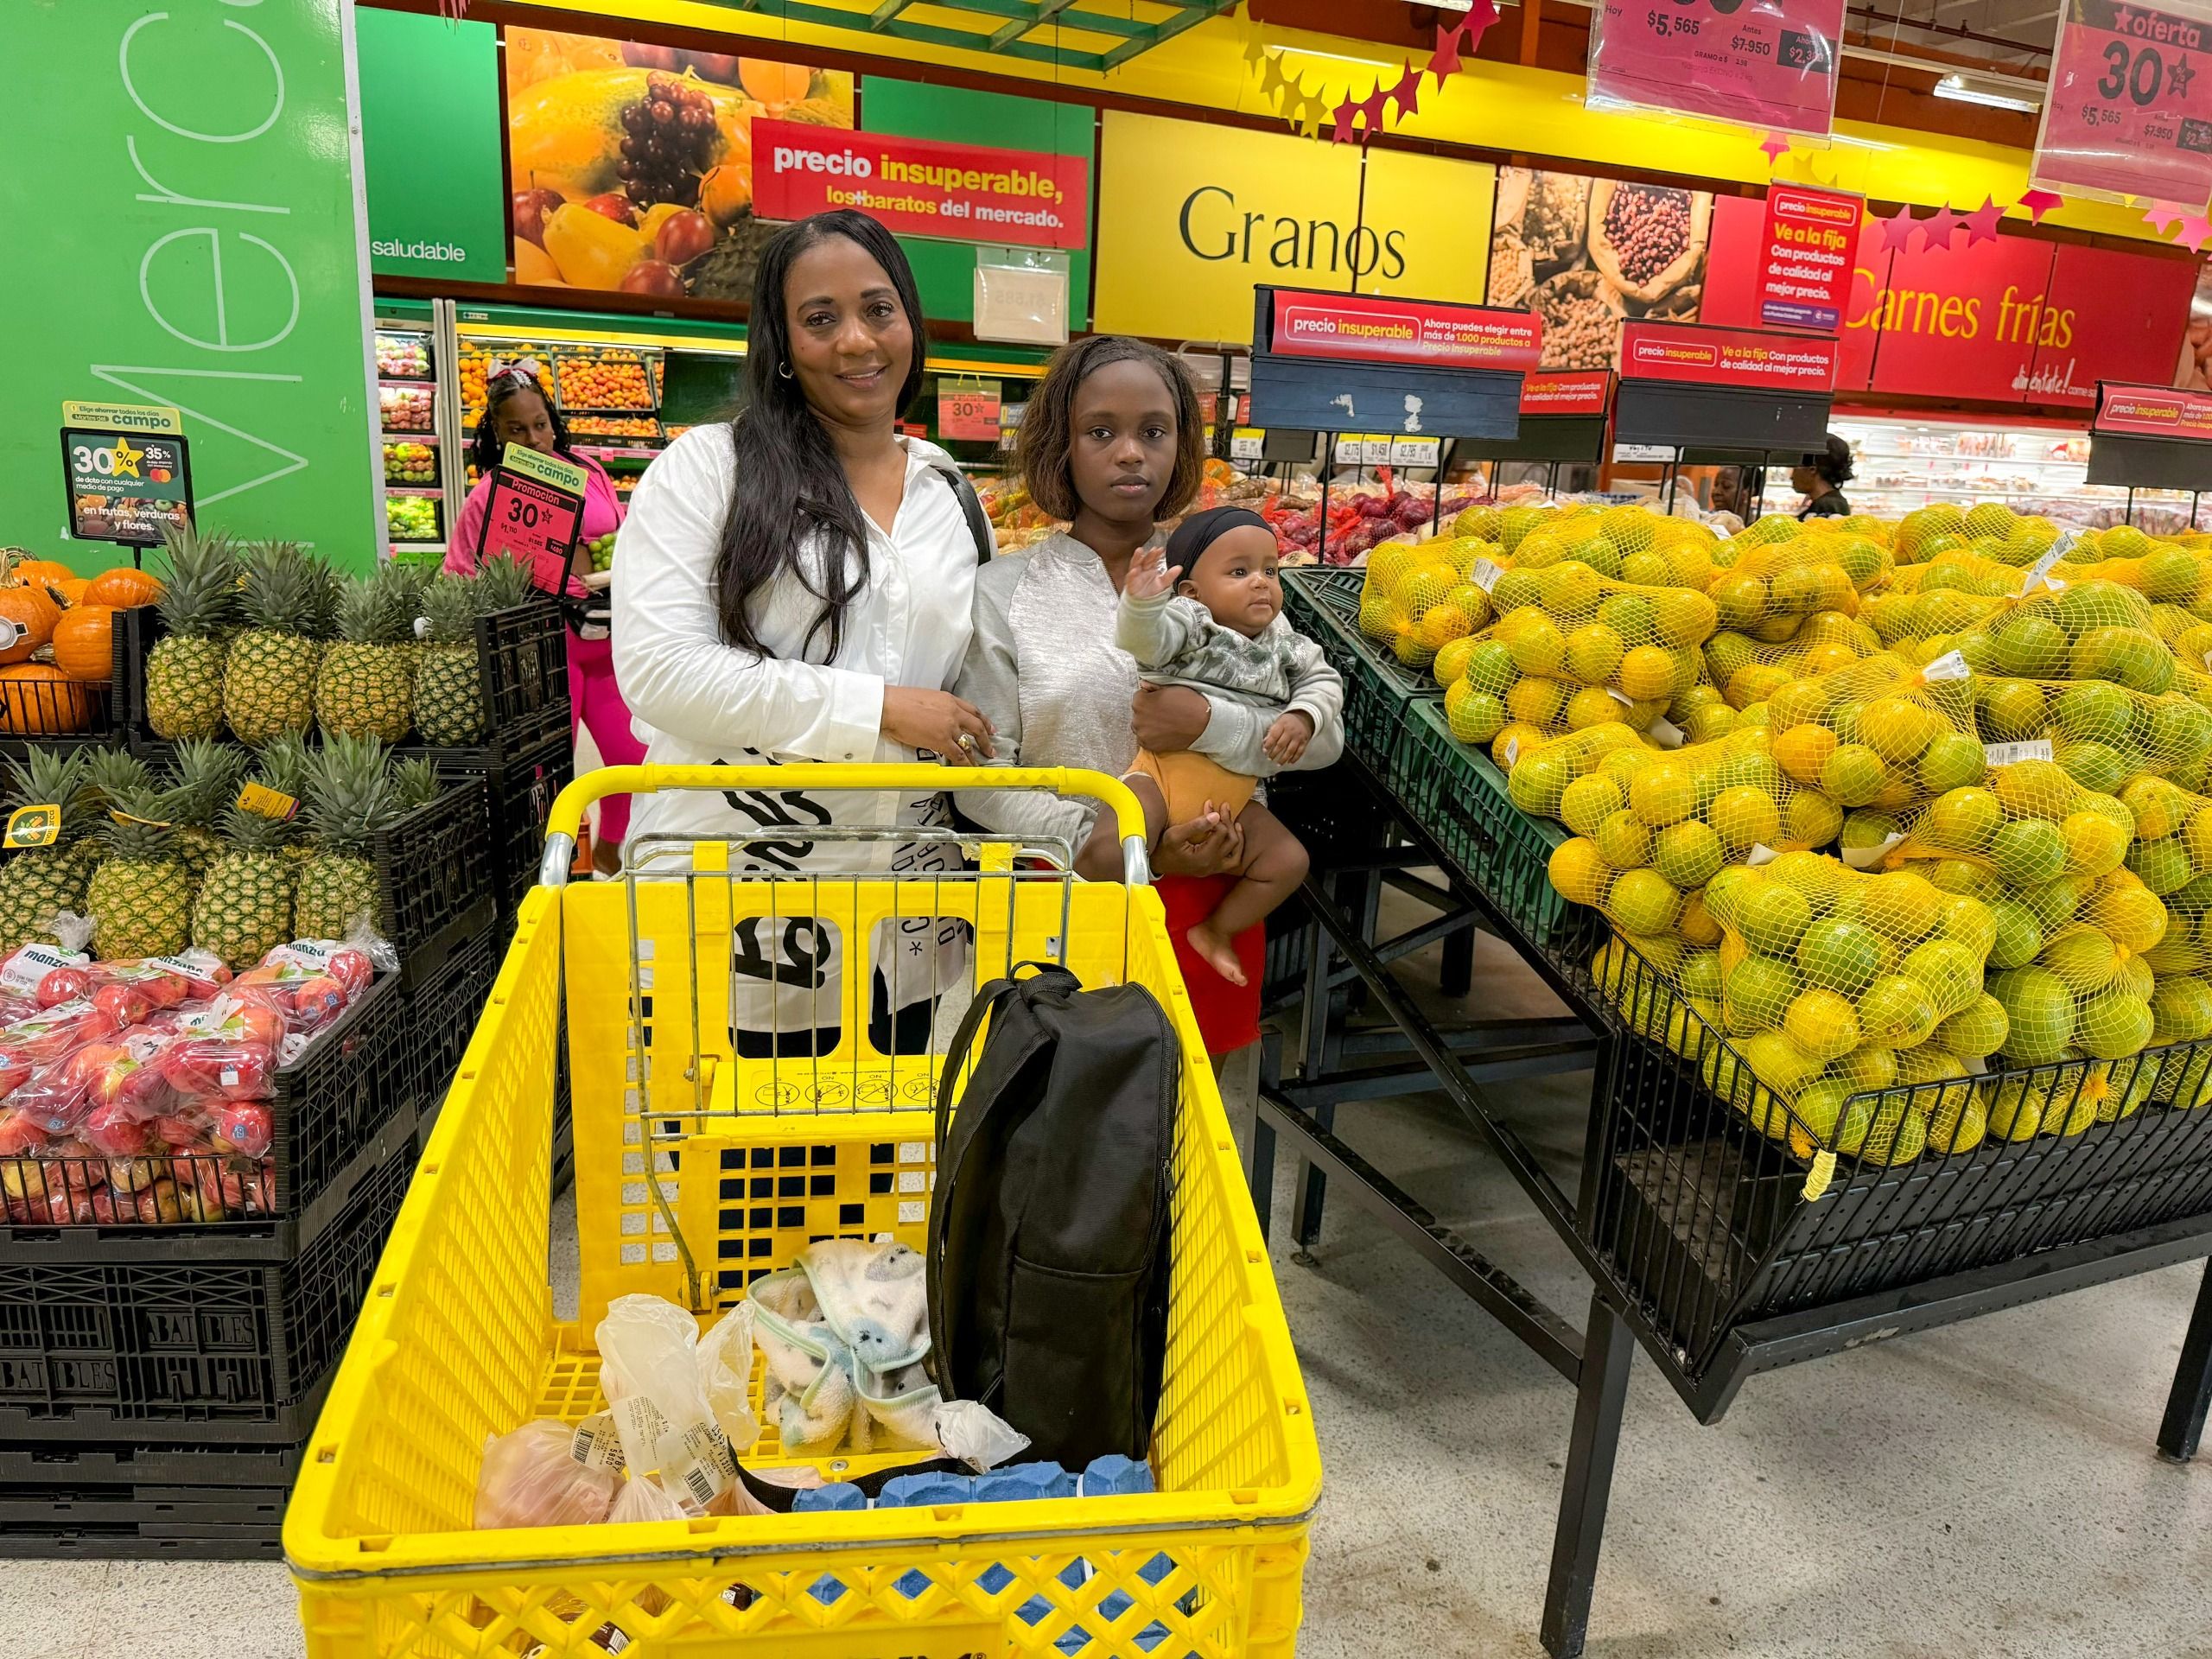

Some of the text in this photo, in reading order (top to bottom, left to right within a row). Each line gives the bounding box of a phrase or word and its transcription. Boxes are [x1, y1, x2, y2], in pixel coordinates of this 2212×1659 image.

[1605, 4, 1623, 17] Hoy
[1647, 10, 1700, 38] $5.565
[1741, 24, 1762, 35] Antes
[2133, 12, 2202, 49] oferta
[1731, 35, 1770, 56] $7.950
[2098, 40, 2163, 106] 30
[2082, 104, 2121, 127] $5.565
[774, 147, 1064, 205] precio insuperable,
[940, 200, 969, 218] del
[976, 206, 1065, 228] mercado.
[1179, 186, 1405, 279] Granos
[1774, 222, 1847, 251] Ve a la fija
[372, 238, 466, 262] saludable
[1770, 245, 1846, 266] Con productos
[1768, 263, 1833, 283] de calidad al
[1765, 282, 1796, 296] mejor
[1845, 268, 2075, 349] Carnes frías
[1294, 317, 1414, 341] precio insuperable
[1423, 319, 1533, 337] Ahora puedes elegir entre
[1423, 329, 1531, 347] más de 1.000 productos a
[1422, 342, 1451, 353] Precio
[1638, 346, 1713, 361] precio insuperable
[1722, 346, 1734, 358] Ve
[1742, 348, 1751, 358] la
[1752, 349, 1769, 361] fija
[1769, 351, 1786, 361] Con
[1786, 353, 1829, 365] productos
[1719, 359, 1827, 378] de calidad al mejor precio.
[953, 403, 974, 416] 30
[2110, 403, 2178, 418] precio insuperable
[112, 415, 171, 429] campo
[114, 479, 144, 487] cualquier
[537, 464, 580, 487] campo
[512, 479, 560, 505] Promoción
[99, 506, 132, 518] frutas,
[134, 509, 181, 521] verduras
[508, 497, 538, 528] 30
[114, 519, 156, 531] y flores.
